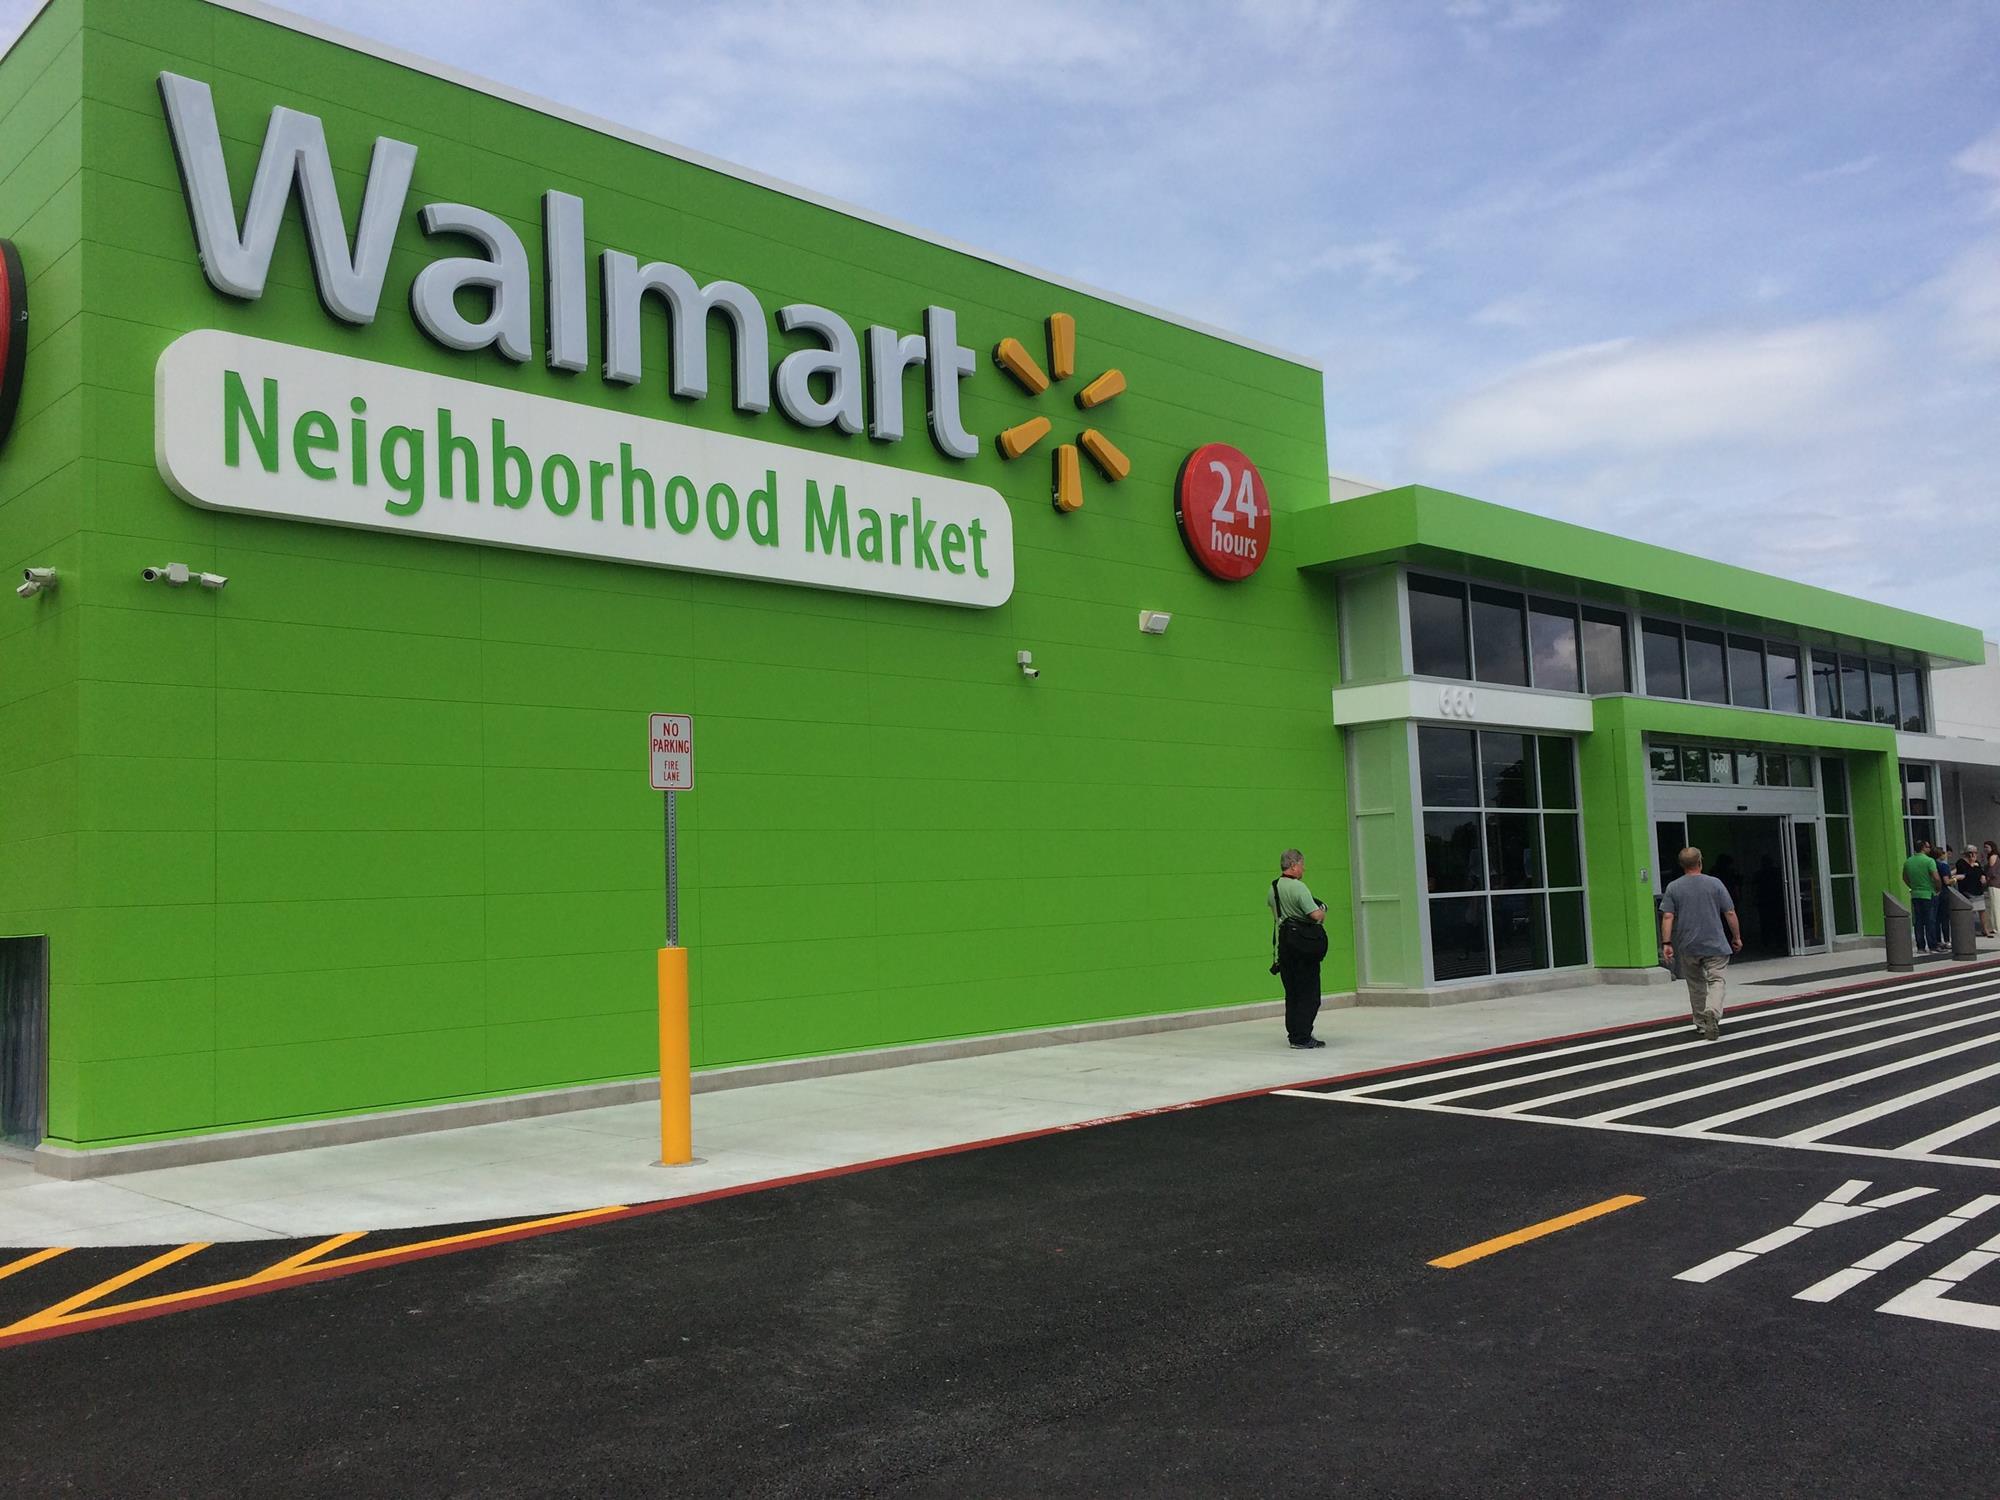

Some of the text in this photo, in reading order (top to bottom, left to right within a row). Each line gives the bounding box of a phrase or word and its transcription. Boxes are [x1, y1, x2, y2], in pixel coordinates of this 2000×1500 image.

[158, 71, 981, 459] Walmart
[223, 370, 989, 578] Neighborhood Market
[1209, 461, 1258, 529] 24
[1211, 522, 1257, 559] hours
[1439, 687, 1476, 718] 660
[663, 722, 679, 737] NO
[653, 738, 690, 754] PARKING
[663, 771, 680, 782] LANE
[664, 760, 679, 771] FIRE
